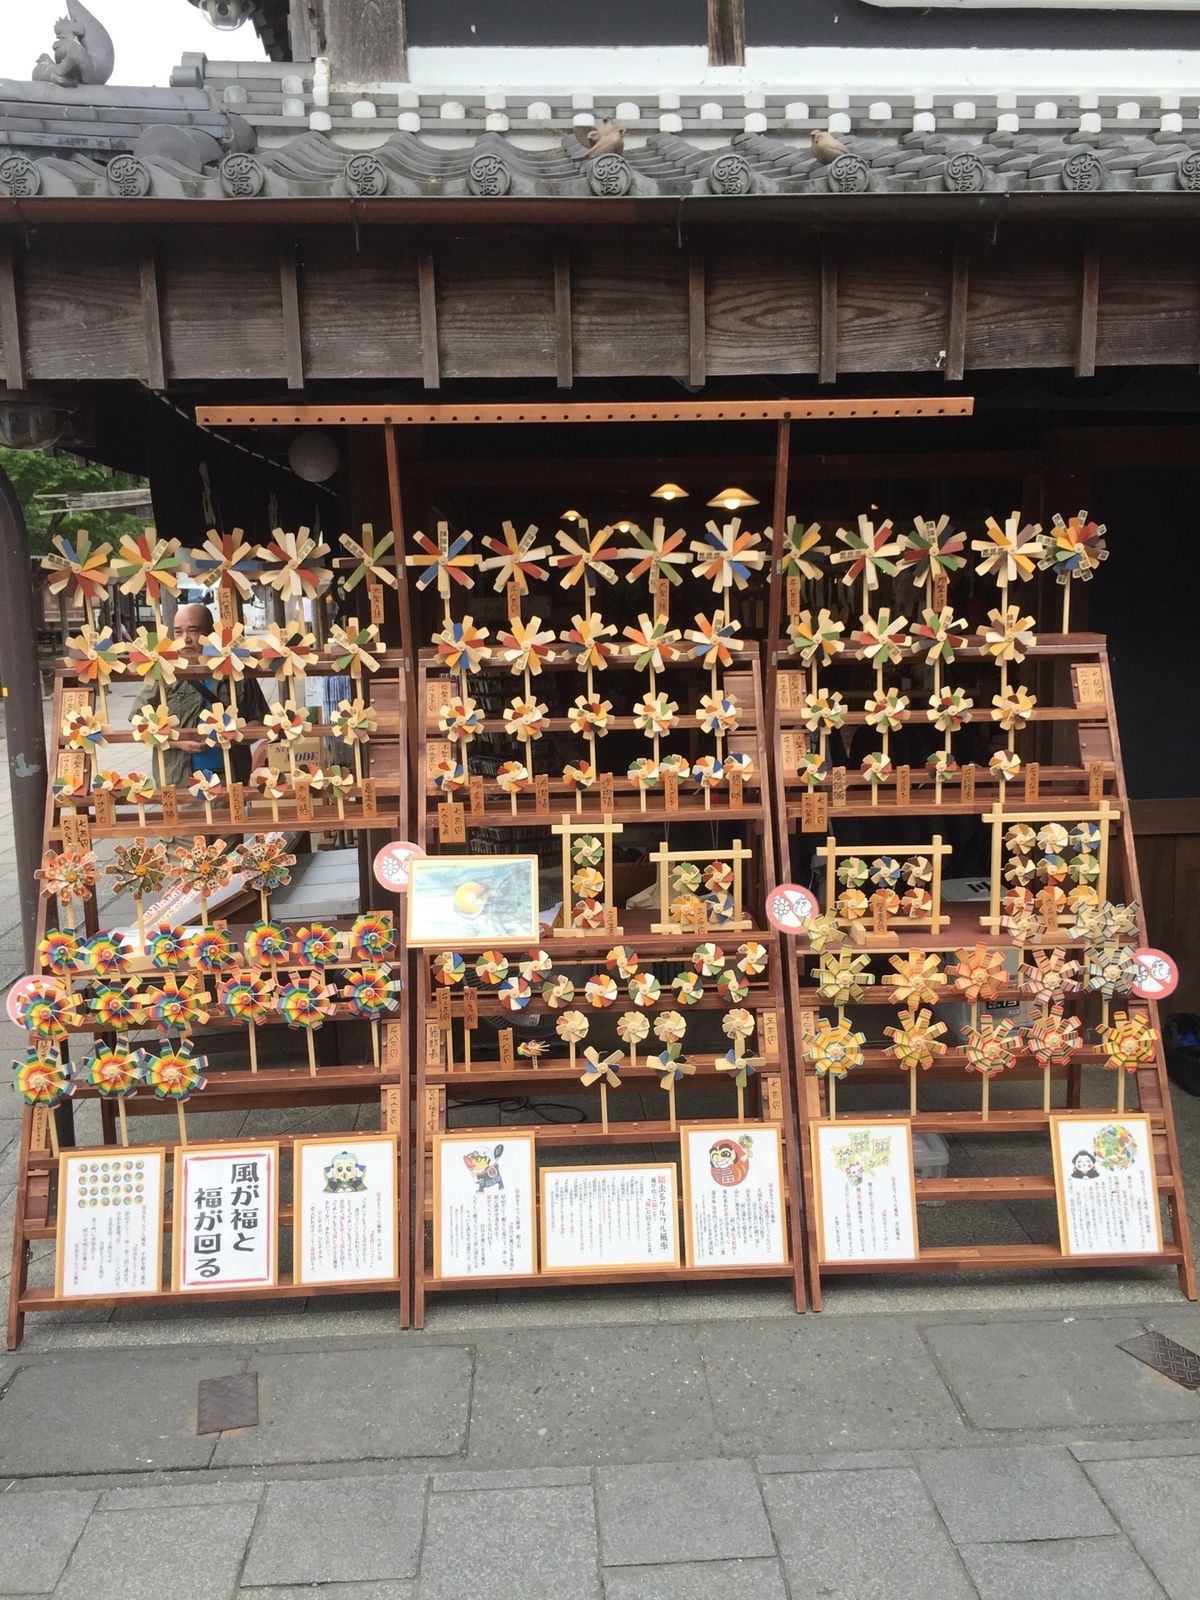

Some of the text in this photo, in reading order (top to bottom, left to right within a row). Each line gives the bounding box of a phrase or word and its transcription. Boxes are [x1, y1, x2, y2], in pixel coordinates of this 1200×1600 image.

[194, 1186, 223, 1278] 福が回る
[230, 1162, 260, 1252] 風が福と
